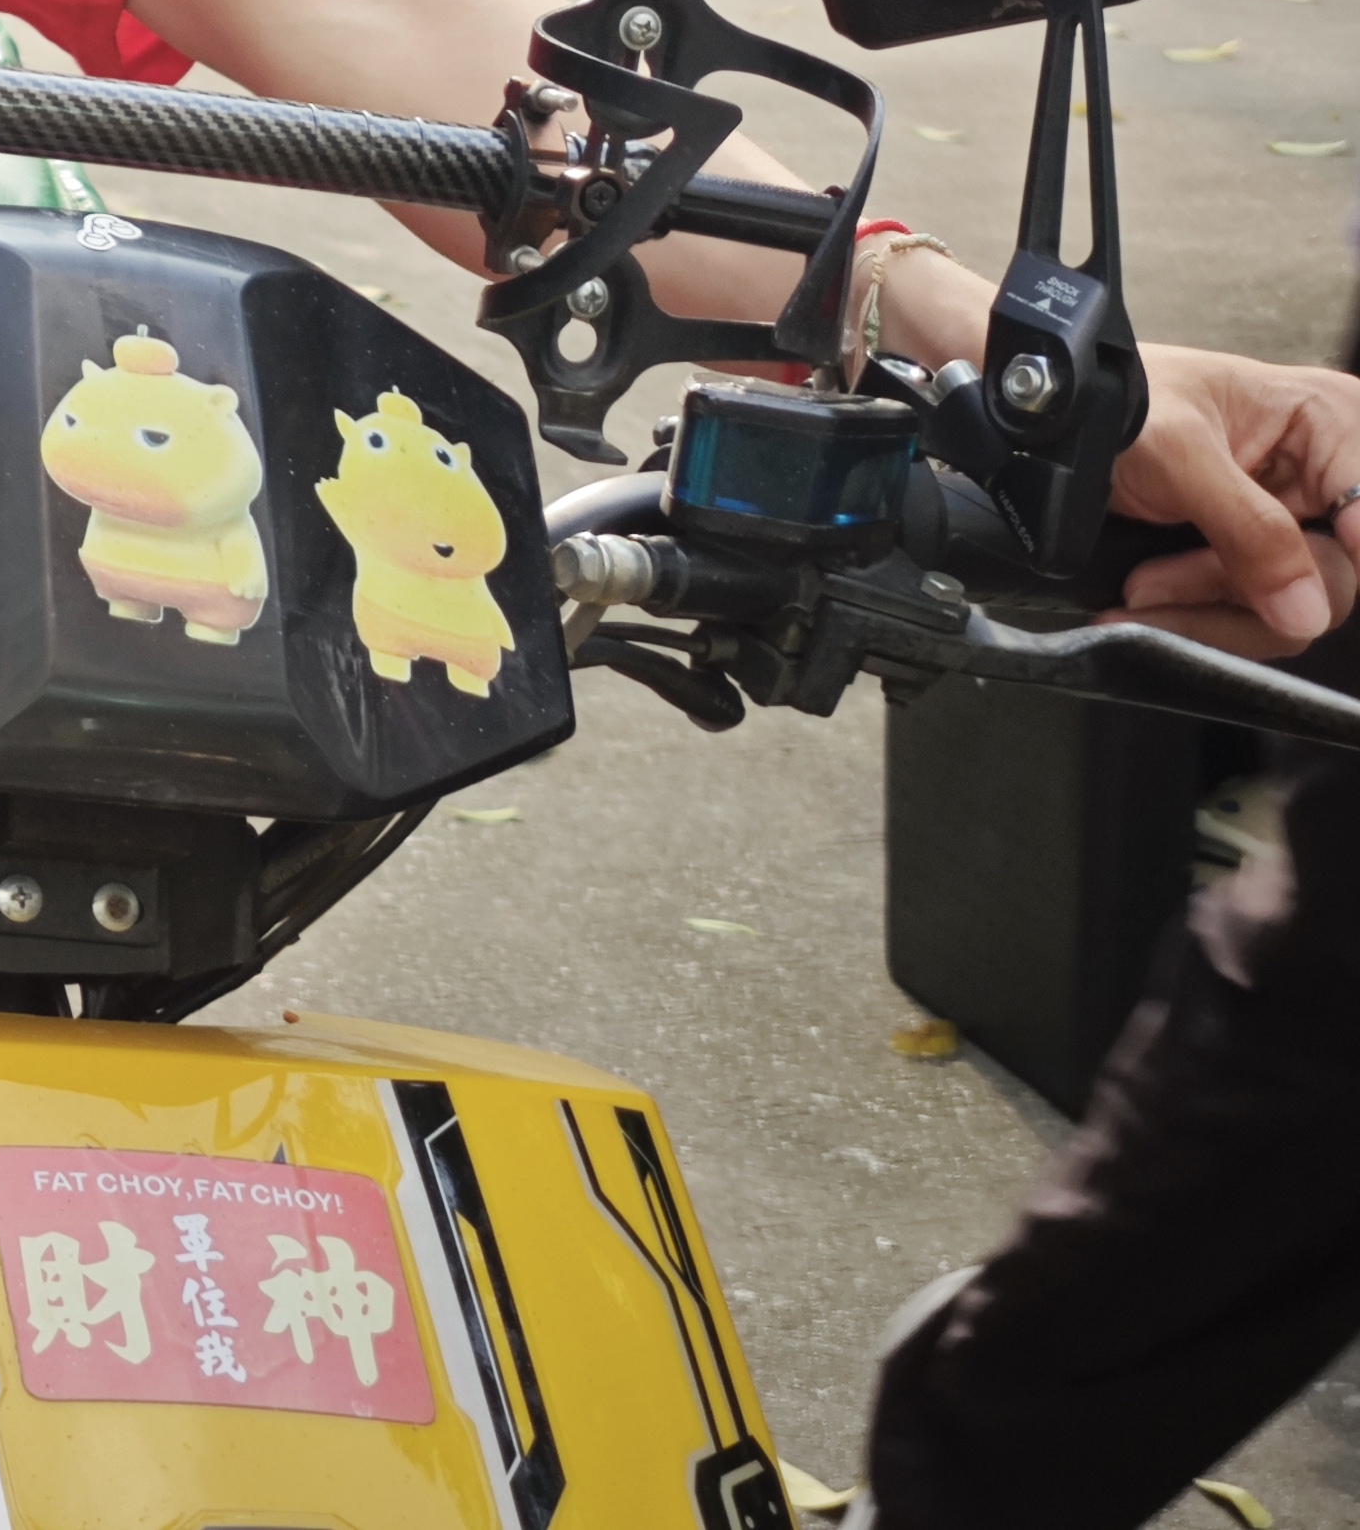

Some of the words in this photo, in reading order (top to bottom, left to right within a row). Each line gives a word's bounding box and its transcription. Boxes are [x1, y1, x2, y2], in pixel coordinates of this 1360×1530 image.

[1046, 276, 1081, 297] SHOCK
[33, 1170, 88, 1193] FAT
[250, 1184, 345, 1215] CHOY!
[18, 1220, 155, 1365] 財
[257, 1233, 395, 1387] 神
